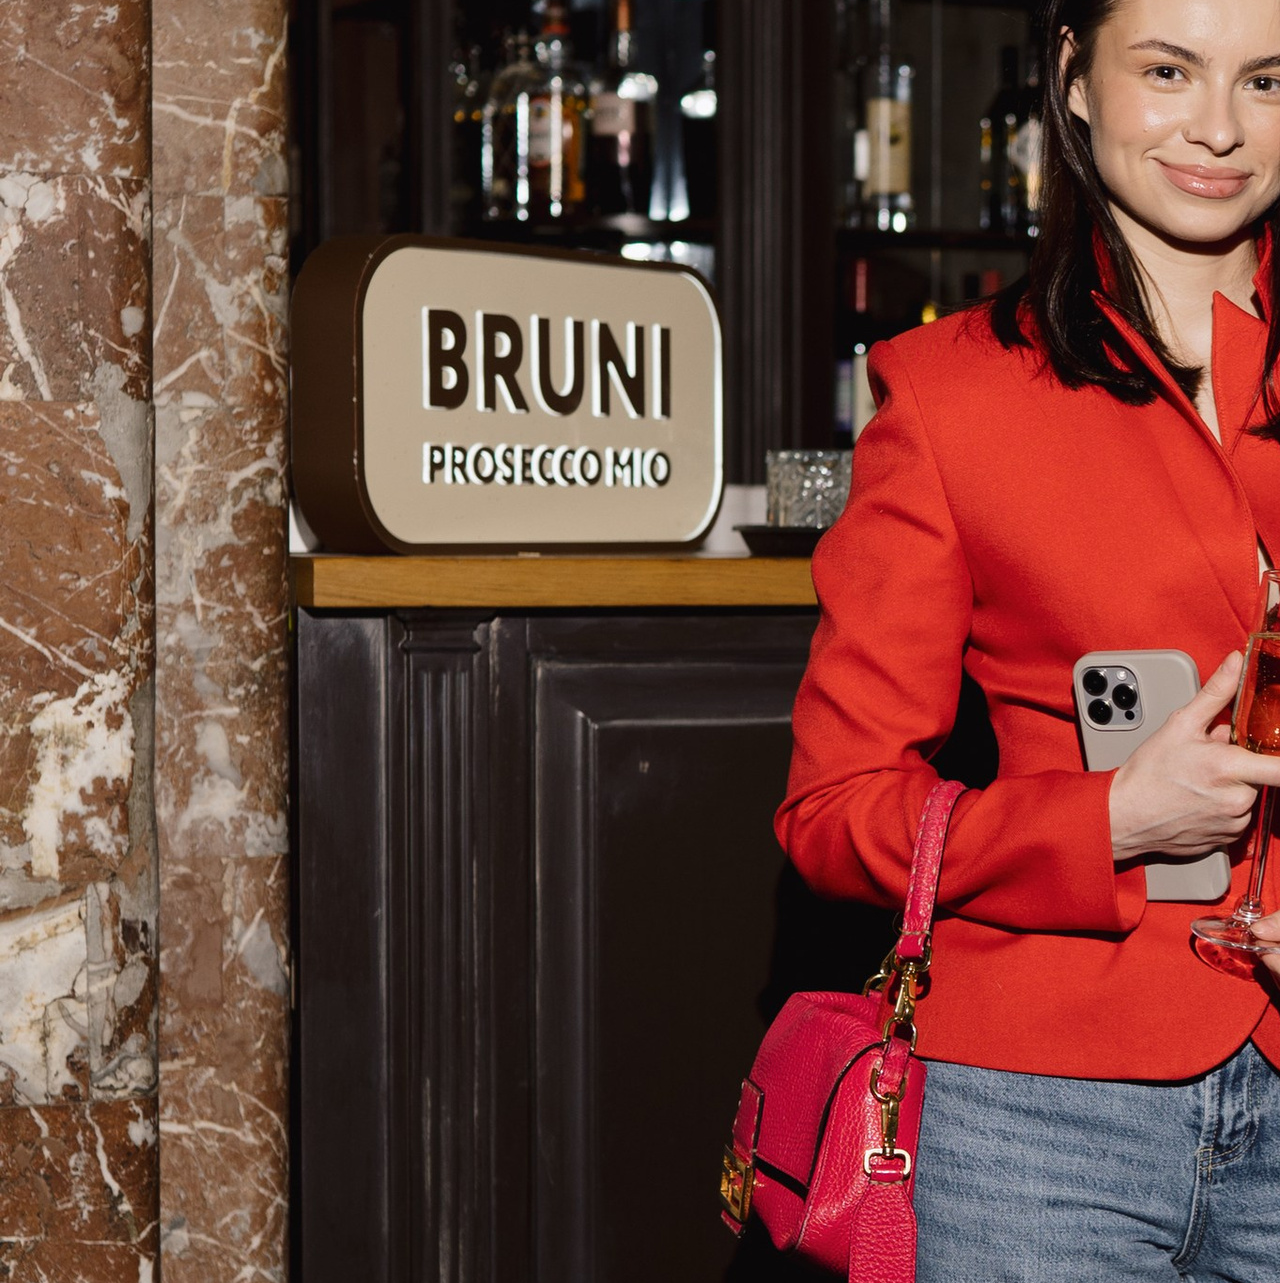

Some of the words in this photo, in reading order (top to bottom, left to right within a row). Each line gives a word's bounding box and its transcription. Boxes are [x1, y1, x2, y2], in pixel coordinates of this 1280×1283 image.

[421, 306, 671, 420] BRUNI
[421, 442, 601, 487] PROSECCO
[605, 446, 671, 488] MIO
